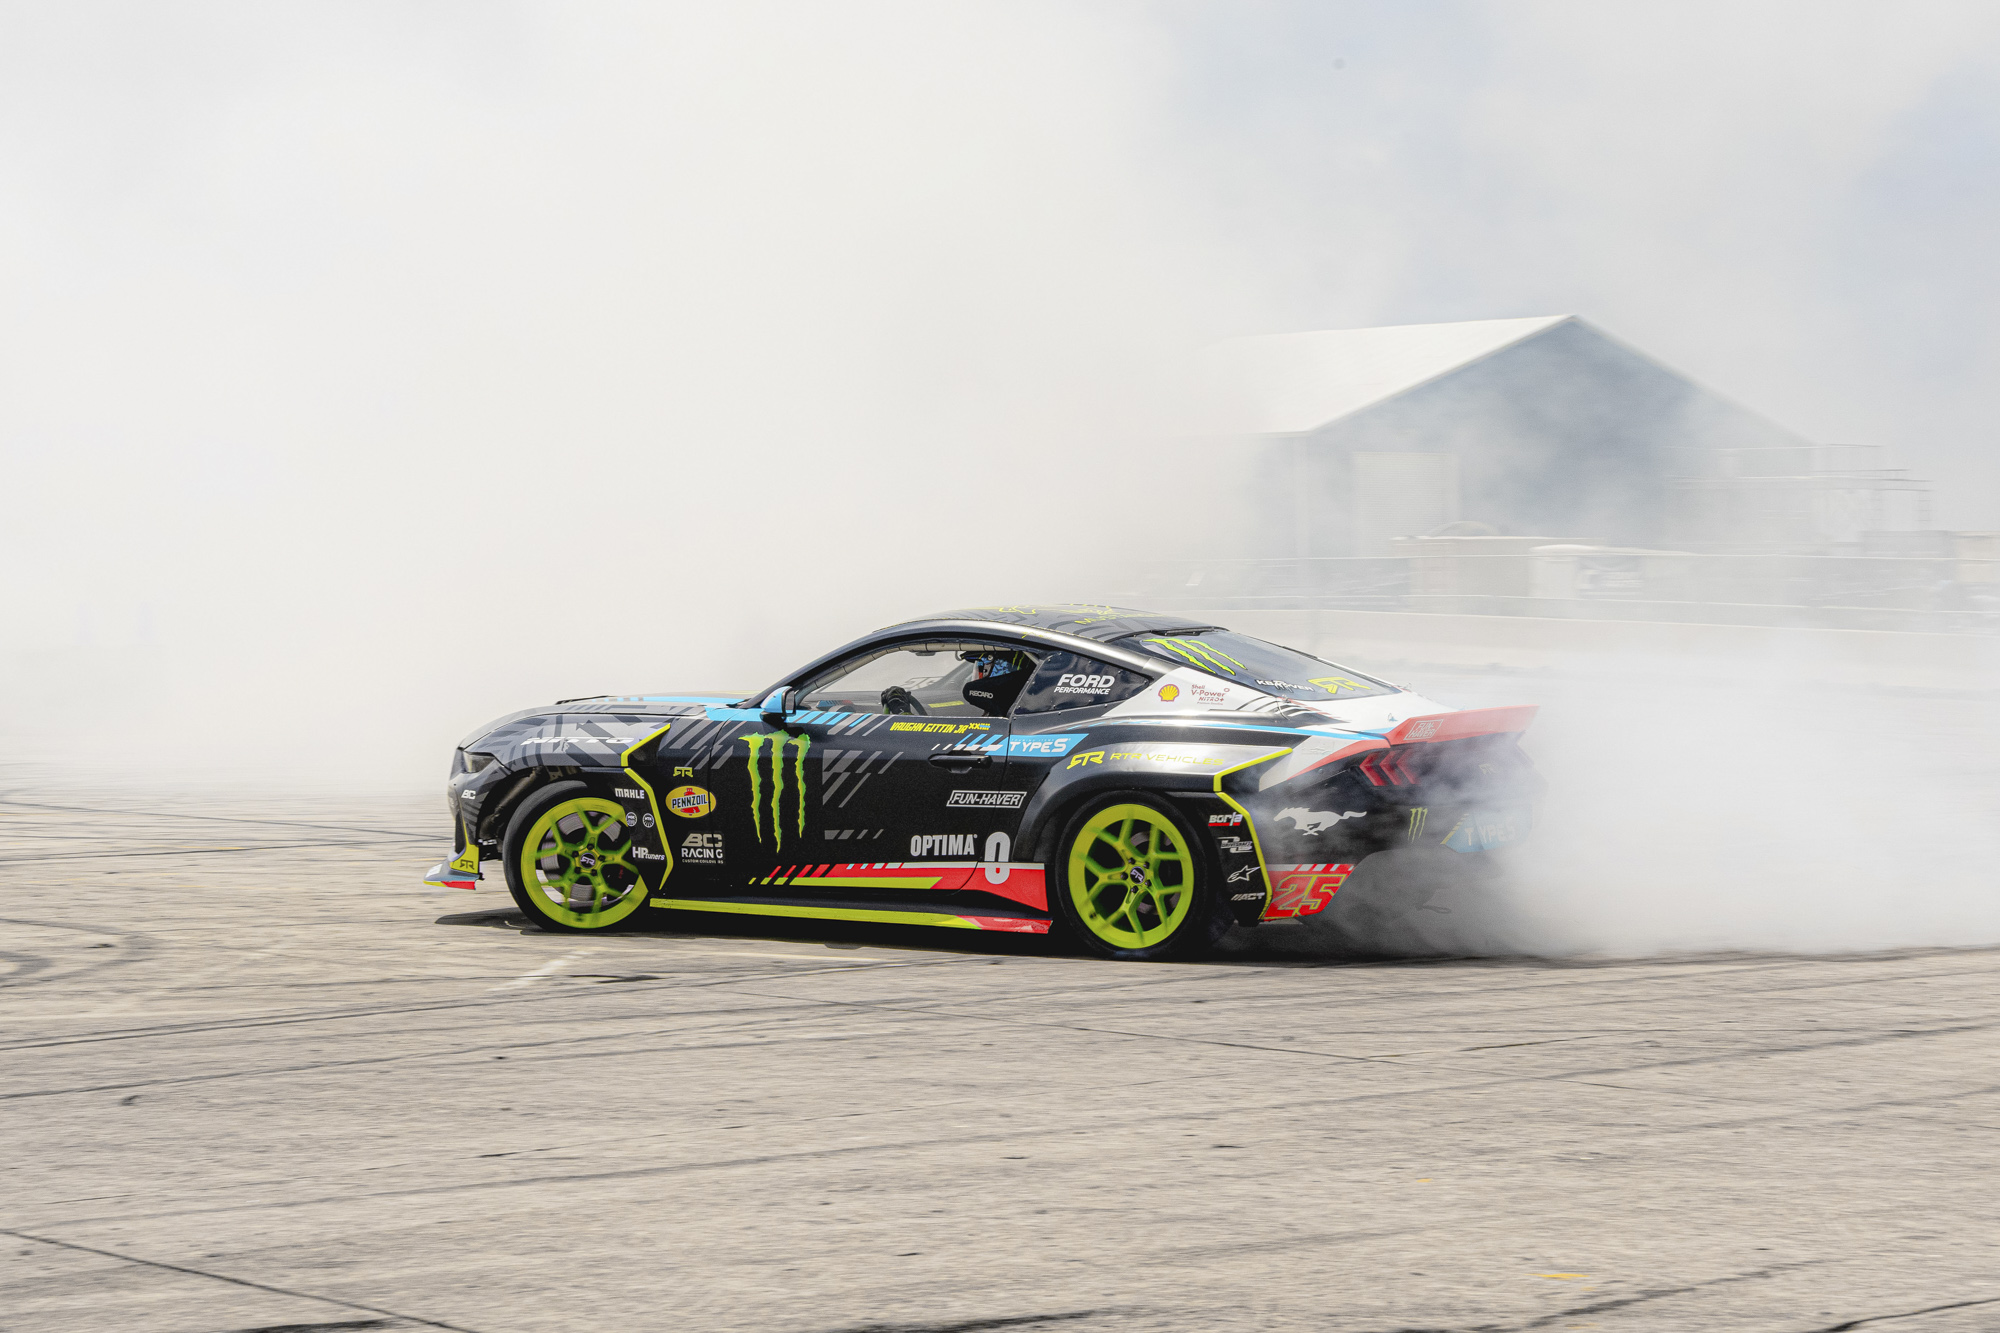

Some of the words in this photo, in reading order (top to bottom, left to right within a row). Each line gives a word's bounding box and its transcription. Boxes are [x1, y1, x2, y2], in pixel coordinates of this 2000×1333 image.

[1057, 674, 1115, 688] FORD
[969, 690, 993, 699] RECARO
[1054, 687, 1110, 695] PERFORMANCE
[889, 722, 924, 731] VAUGHN
[923, 723, 954, 733] GITTIN
[953, 724, 968, 734] JR
[520, 736, 635, 746] NITTO
[1110, 752, 1142, 761] RTR
[1146, 754, 1224, 766] VEHICLES
[461, 789, 476, 799] BC
[615, 788, 645, 799] MAHLE
[951, 793, 1022, 806] FUN-HAVER
[671, 794, 708, 809] PENNZOIL
[682, 833, 723, 848] BC
[911, 834, 975, 856] OPTIMA
[681, 848, 723, 859] RACING
[1263, 874, 1347, 918] 25
